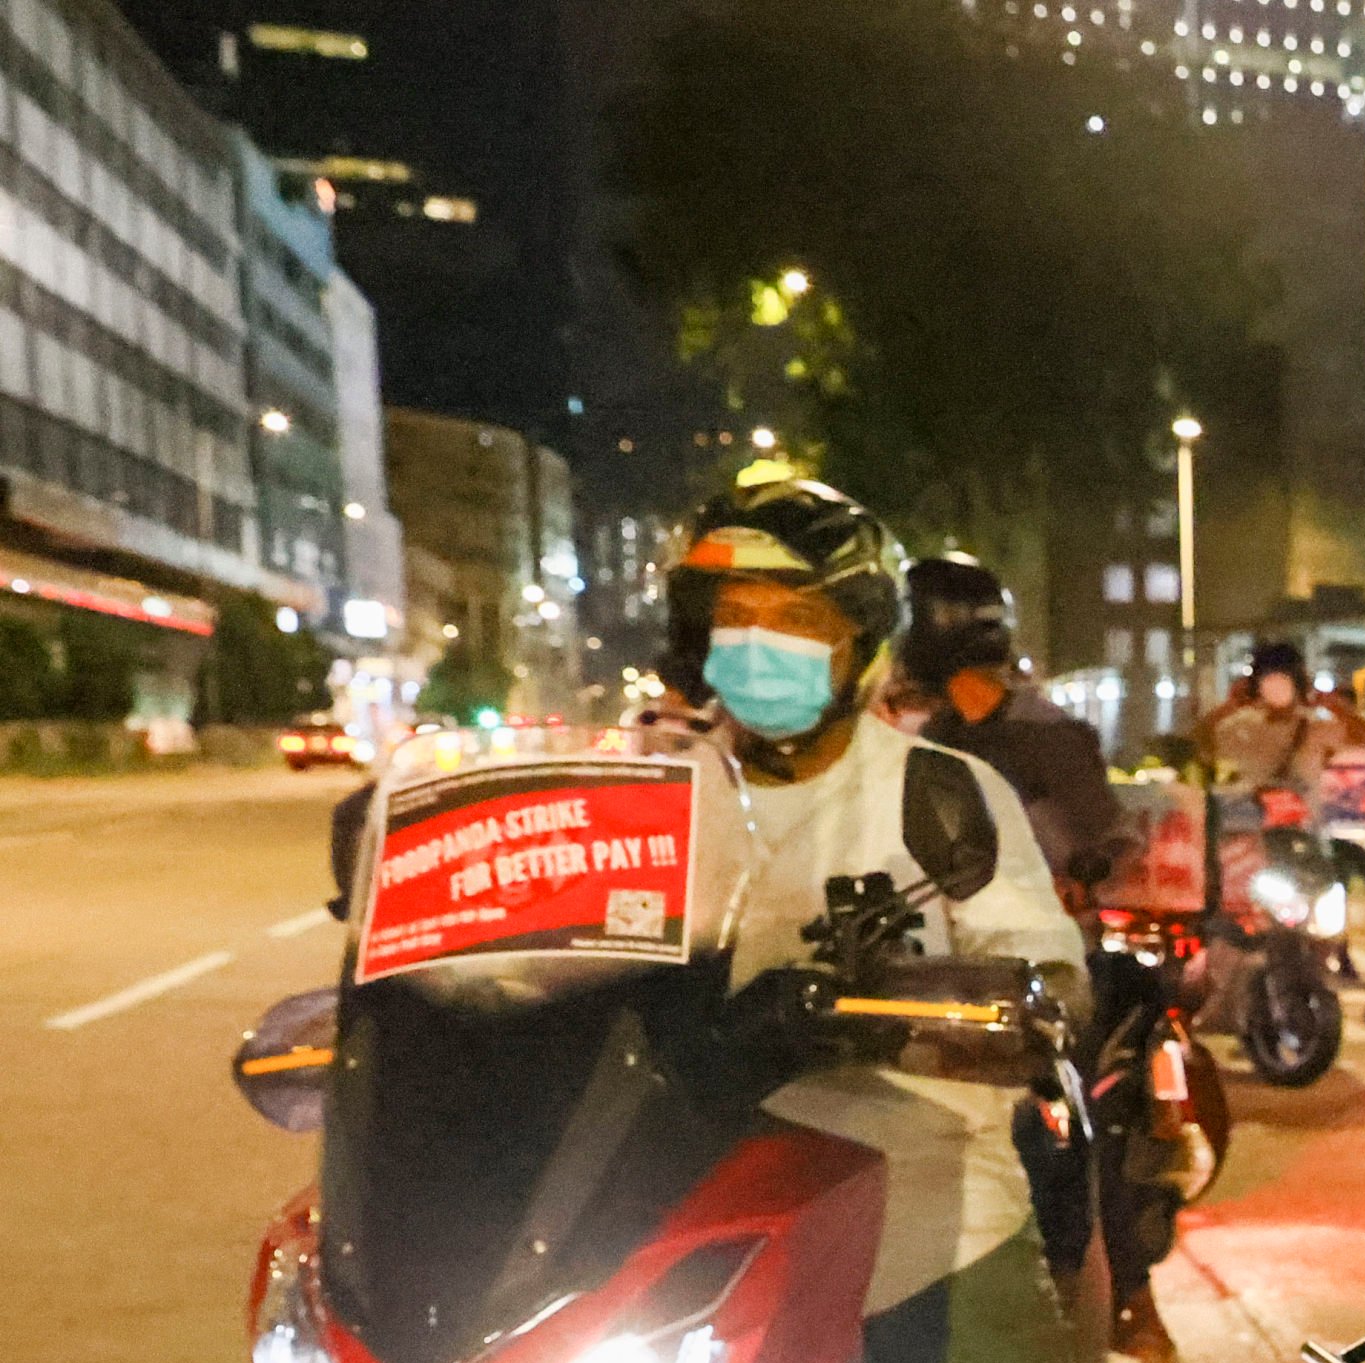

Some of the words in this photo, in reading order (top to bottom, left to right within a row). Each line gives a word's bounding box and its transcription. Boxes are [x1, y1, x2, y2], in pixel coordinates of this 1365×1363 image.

[502, 799, 591, 839] STRIKE
[451, 862, 493, 902] FOR
[496, 842, 588, 887] BETTER
[592, 837, 643, 872] PAY
[647, 834, 679, 867] !!!
